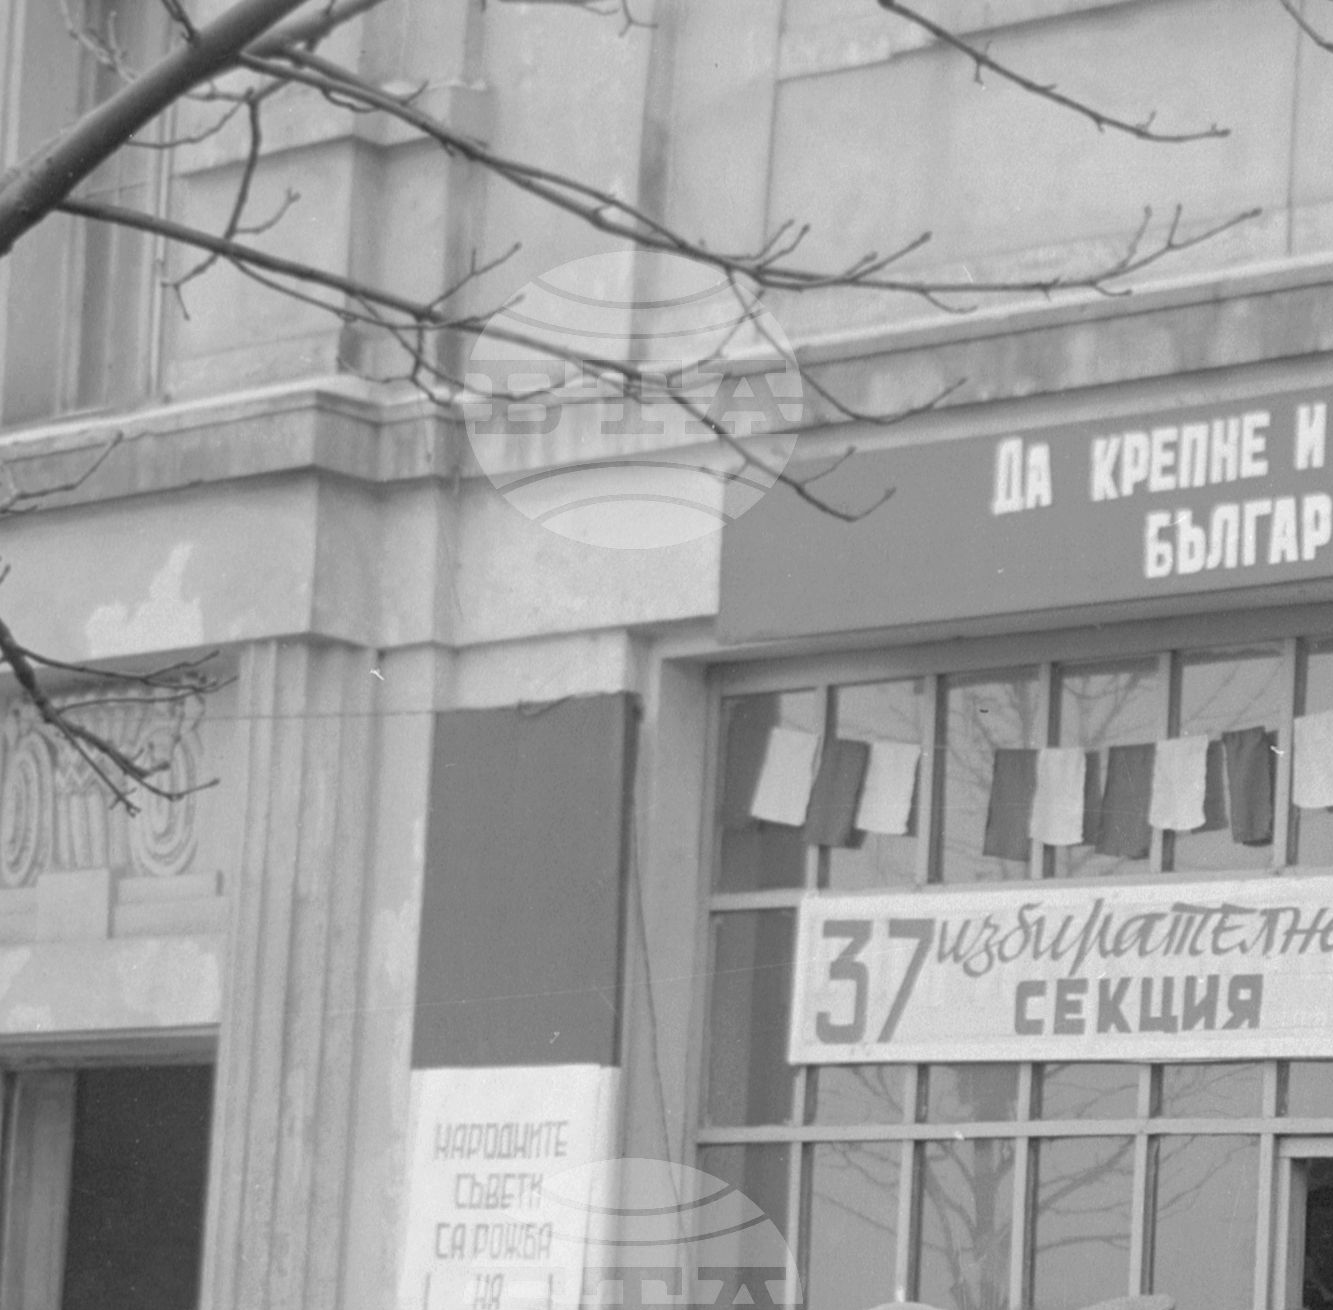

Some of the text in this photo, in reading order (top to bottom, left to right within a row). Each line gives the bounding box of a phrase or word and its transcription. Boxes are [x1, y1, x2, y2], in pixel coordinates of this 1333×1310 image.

[992, 436, 1052, 515] ДА
[1090, 410, 1271, 502] КРЕПНЕ
[1295, 403, 1328, 471] И
[815, 918, 936, 1044] 37
[1012, 973, 1265, 1036] СЕКЦИЯ
[434, 1121, 568, 1160] НАРОДНИТЕ
[455, 1173, 544, 1211] СЪВЕТИ
[436, 1222, 553, 1260] СА РОЖБА
[472, 1273, 504, 1310] НА
